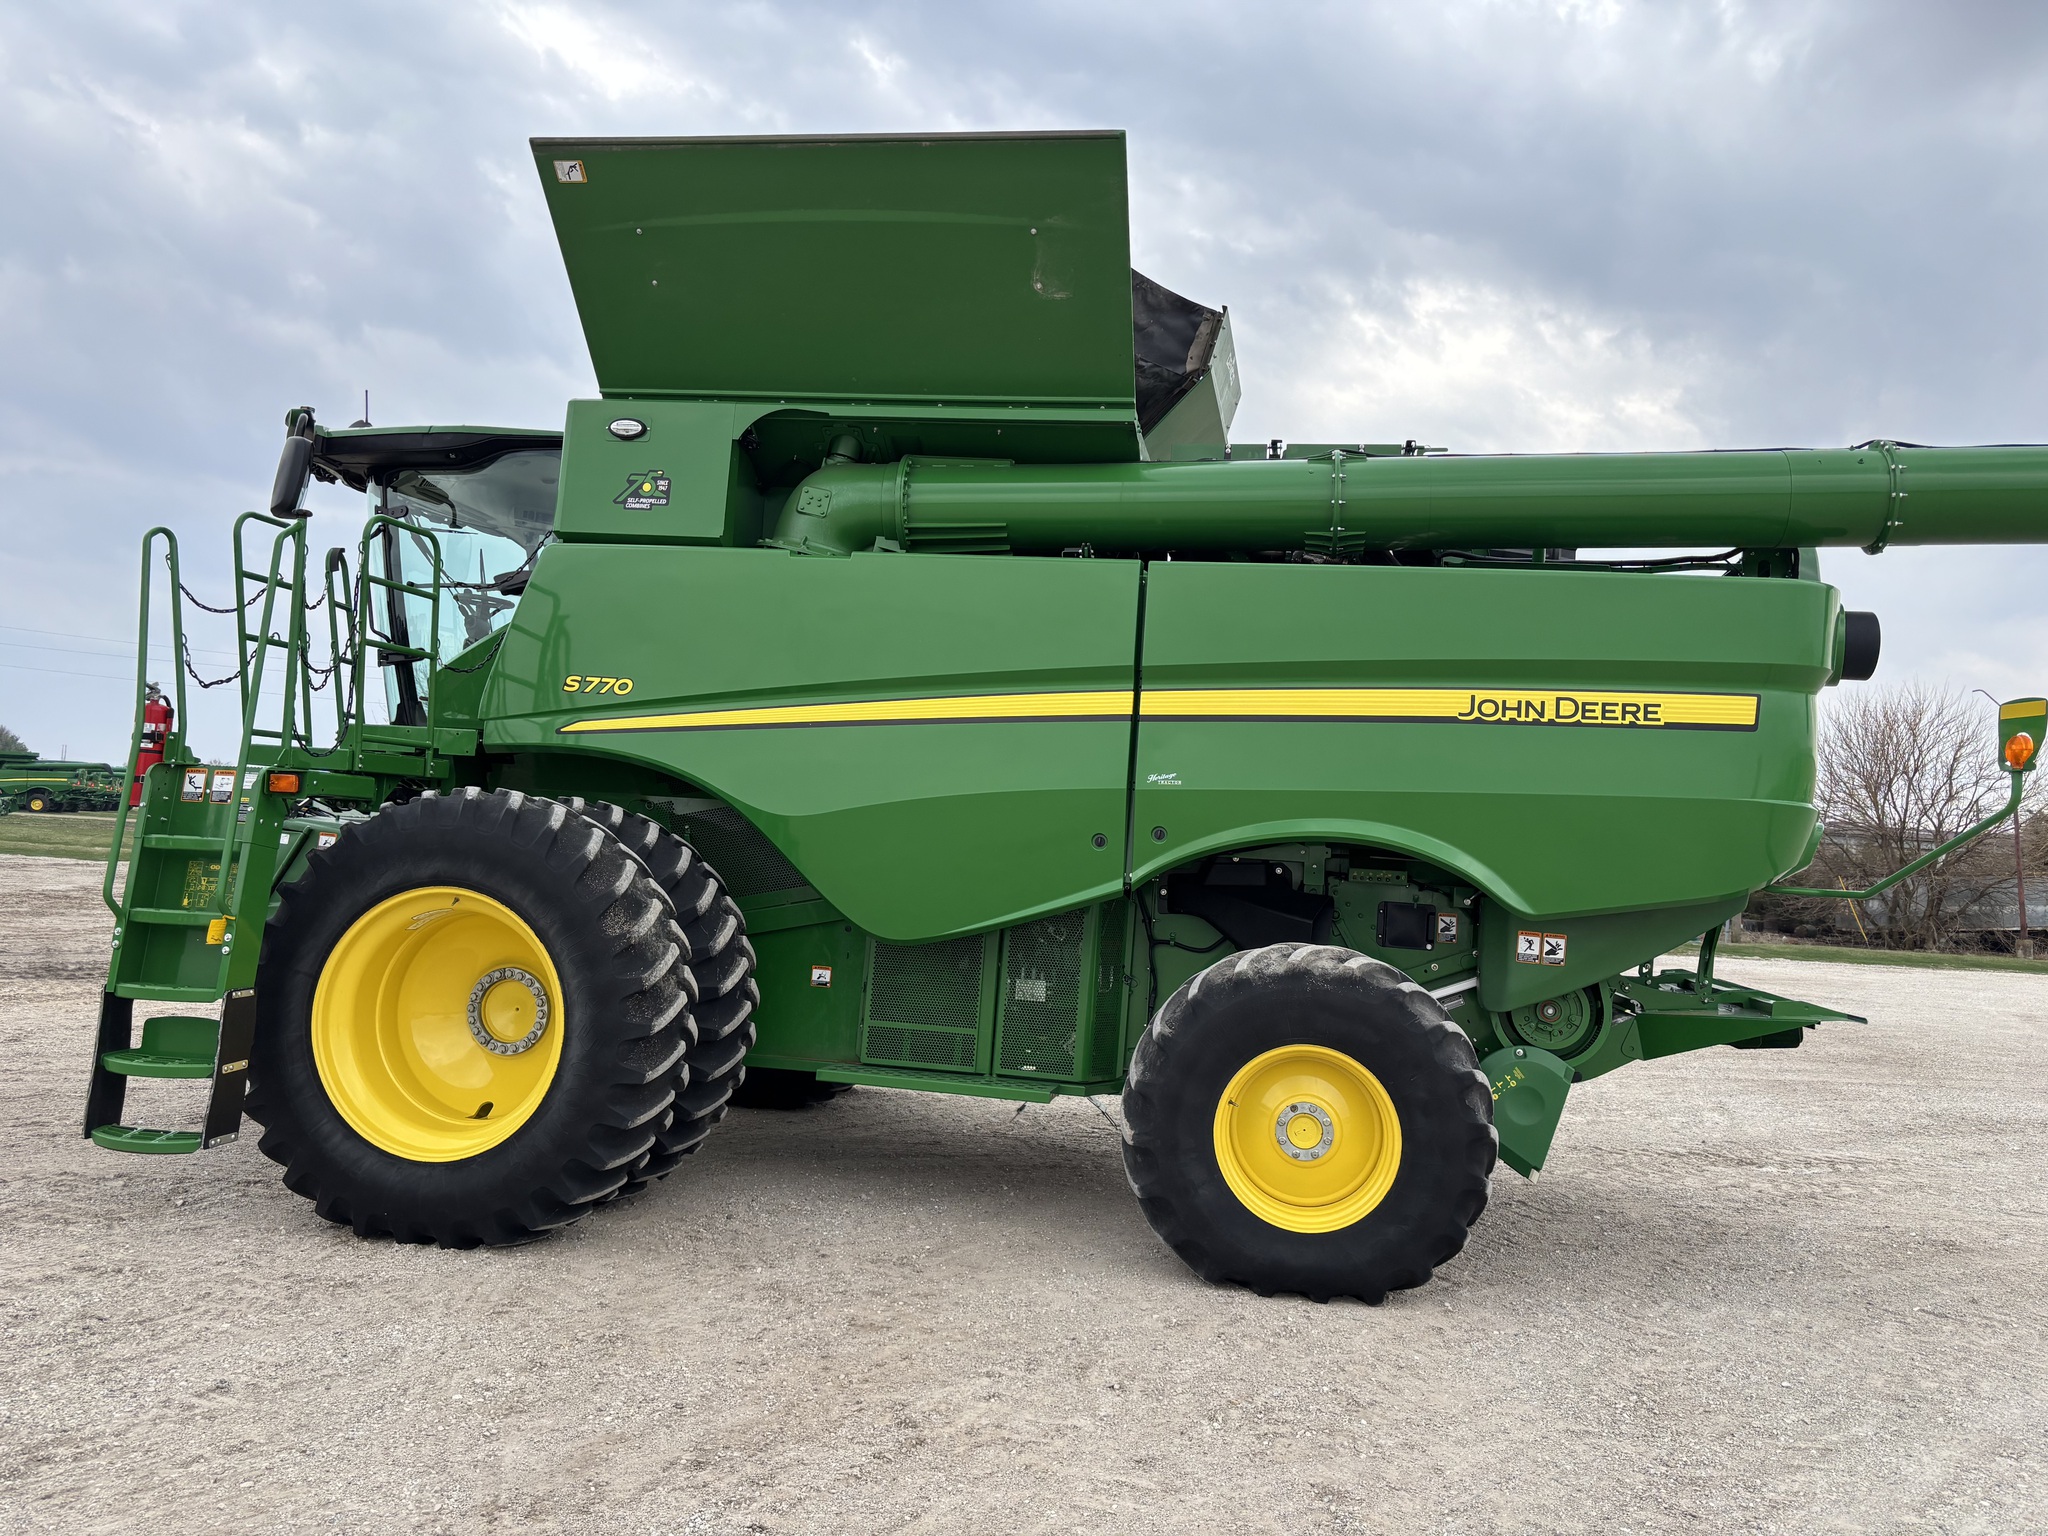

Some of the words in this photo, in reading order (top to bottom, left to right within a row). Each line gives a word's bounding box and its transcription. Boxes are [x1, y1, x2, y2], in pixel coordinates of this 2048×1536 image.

[562, 674, 634, 696] S770
[1458, 694, 1546, 718] JOHN
[1555, 697, 1662, 722] DEERE
[1146, 772, 1177, 784] Heritage
